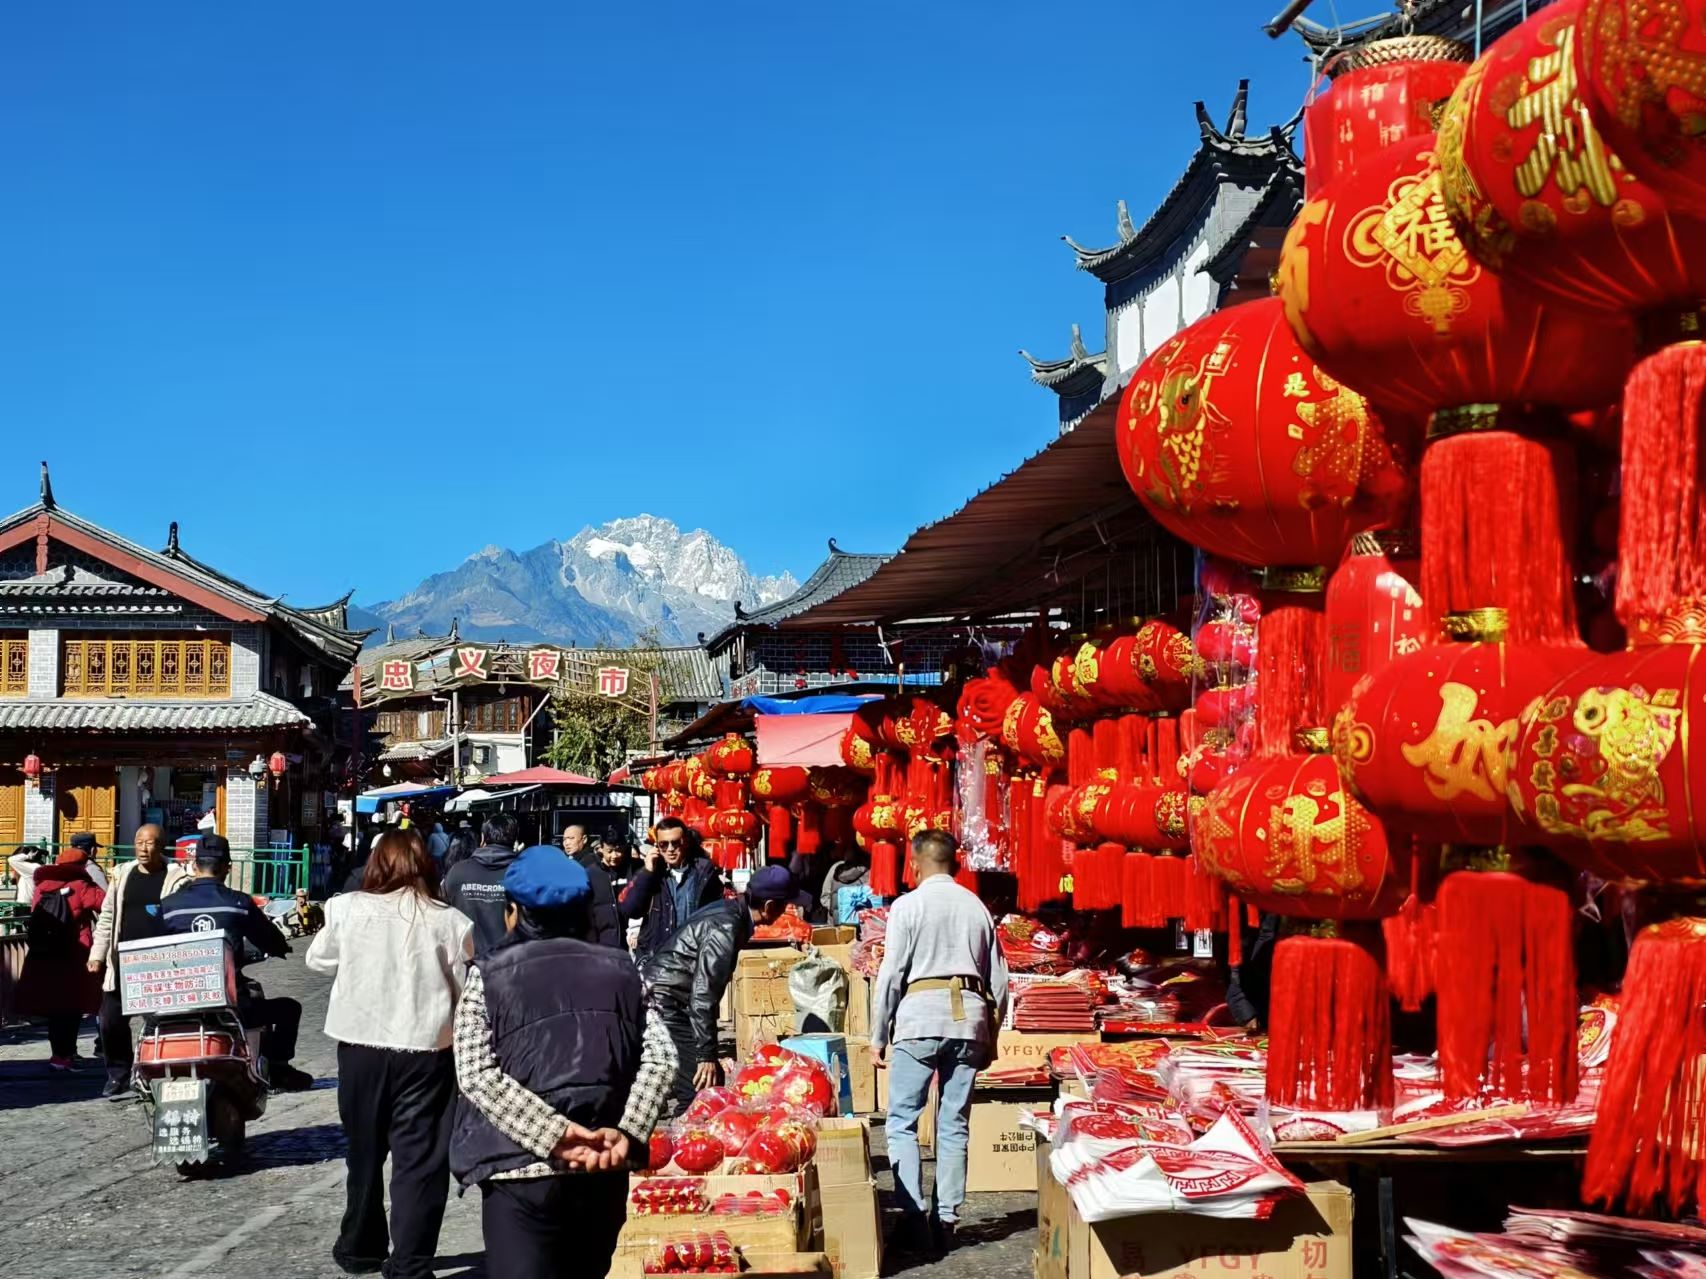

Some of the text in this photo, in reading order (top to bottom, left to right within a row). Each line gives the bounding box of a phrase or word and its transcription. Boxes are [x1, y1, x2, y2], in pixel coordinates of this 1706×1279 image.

[1389, 195, 1463, 260] 福
[383, 647, 629, 698] 忠义夜市
[1002, 1045, 1044, 1056] YFGY
[1301, 1240, 1328, 1269] 切
